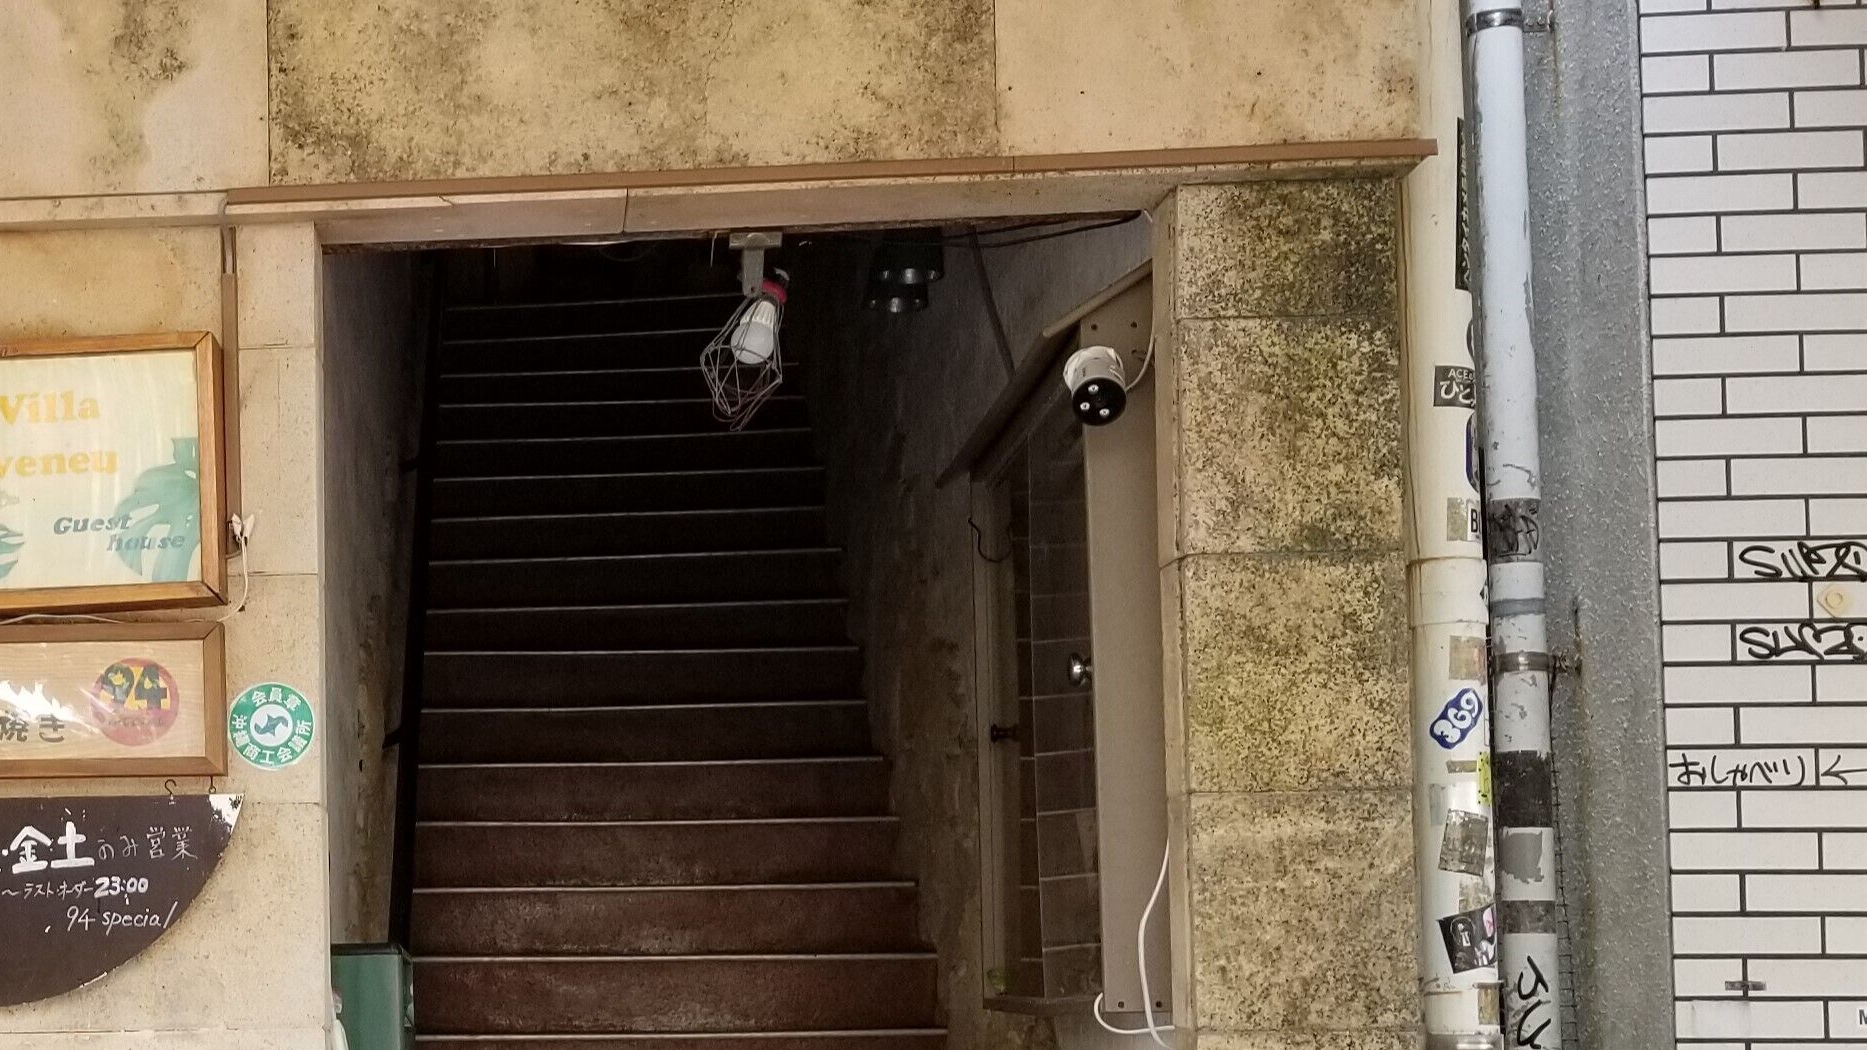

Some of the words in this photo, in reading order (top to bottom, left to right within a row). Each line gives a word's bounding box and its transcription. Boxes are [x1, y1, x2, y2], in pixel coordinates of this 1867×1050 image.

[53, 513, 133, 535] Guest
[106, 532, 186, 552] house
[67, 905, 95, 932] 94
[101, 901, 178, 936] special
